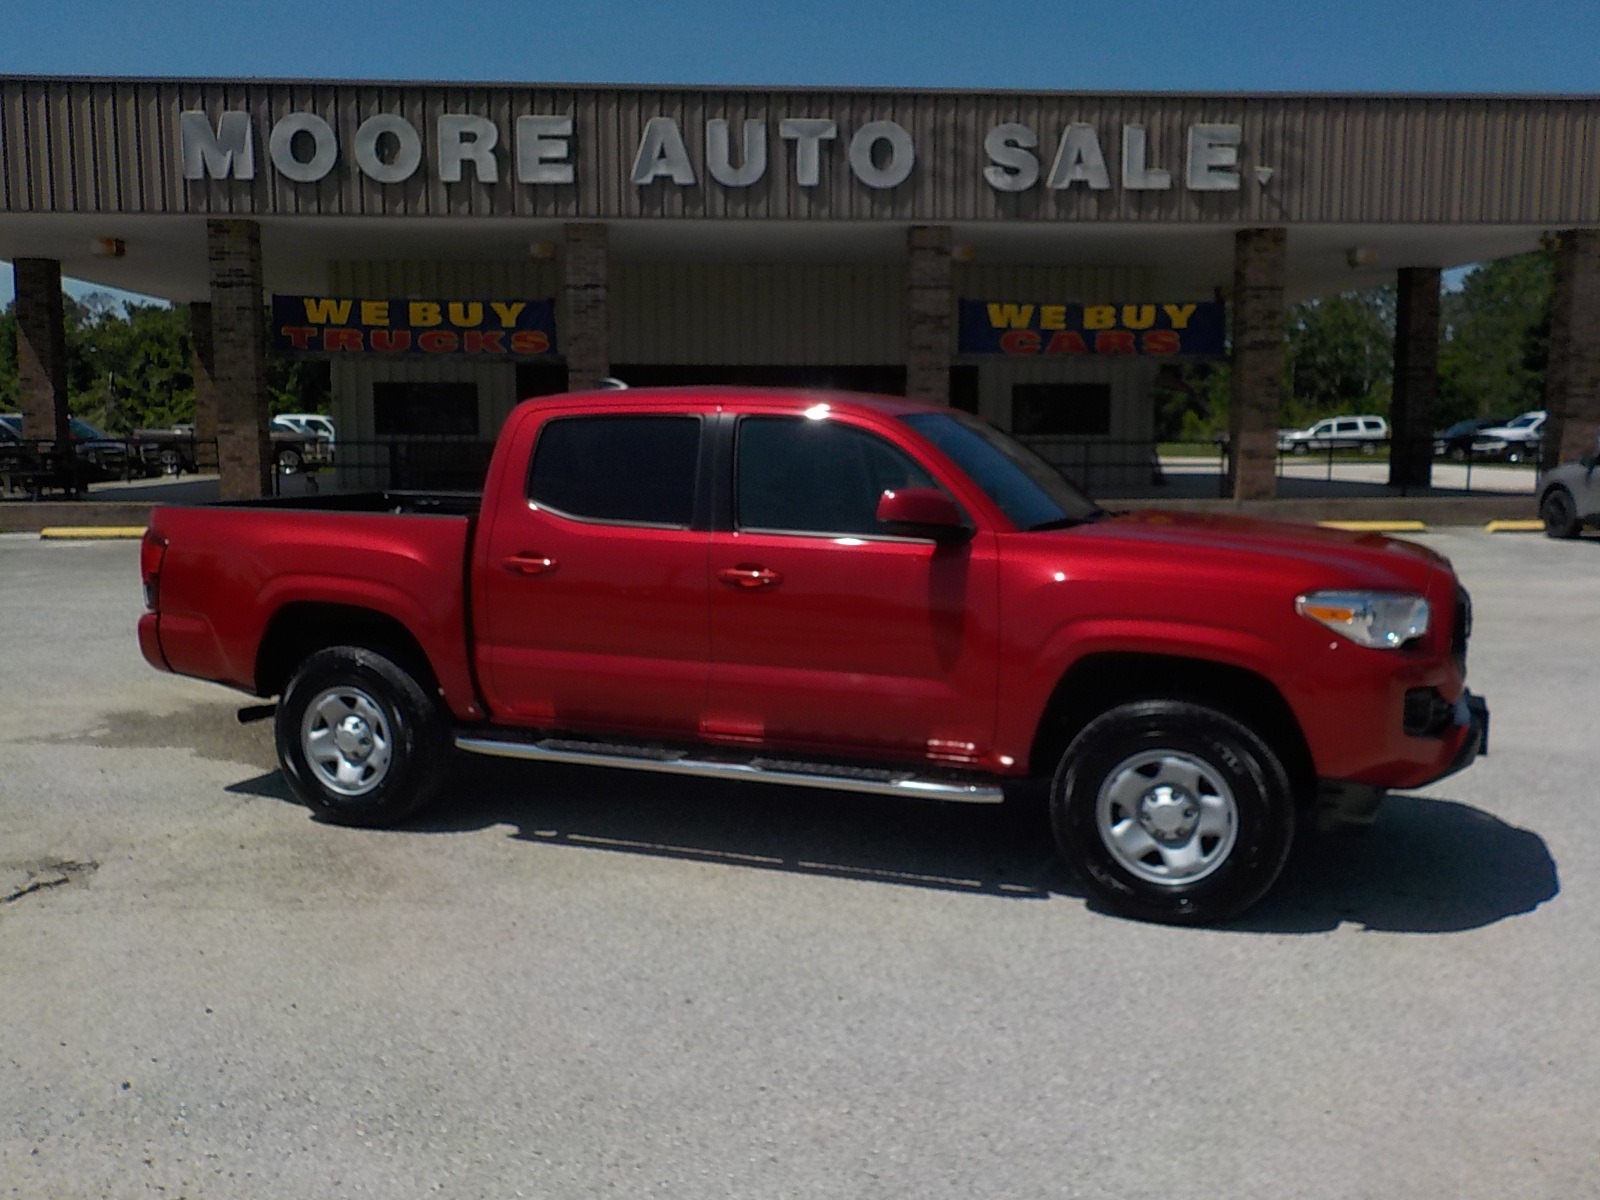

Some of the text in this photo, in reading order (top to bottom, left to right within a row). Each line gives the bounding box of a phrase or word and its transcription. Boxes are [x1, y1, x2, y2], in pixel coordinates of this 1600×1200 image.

[180, 109, 1274, 193] MOORE AUTO SALE
[303, 297, 527, 328] WE BUY
[987, 303, 1197, 330] WE BUY
[281, 325, 550, 354] TRUCKS
[1000, 329, 1181, 356] CARS
